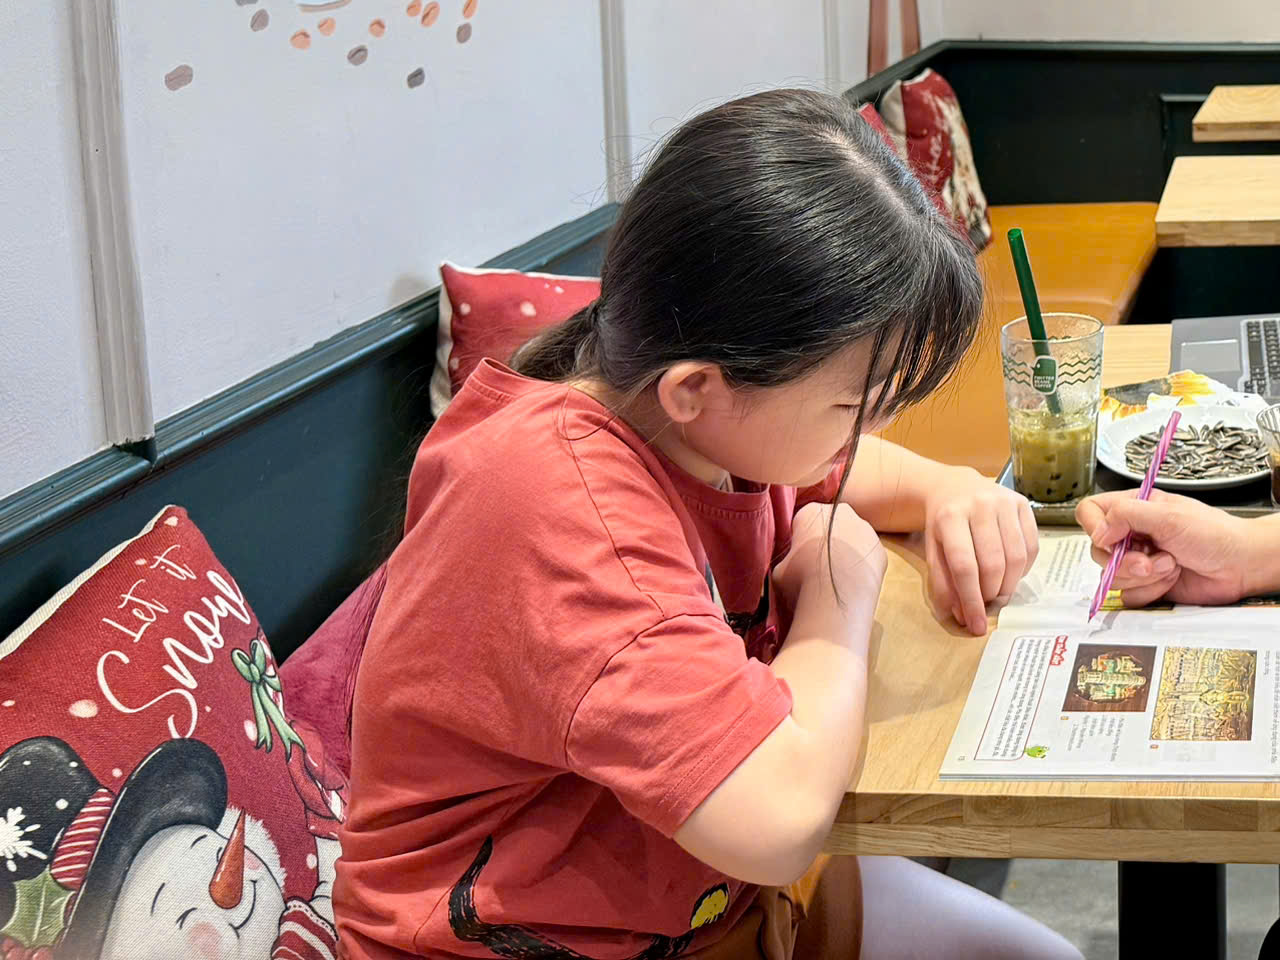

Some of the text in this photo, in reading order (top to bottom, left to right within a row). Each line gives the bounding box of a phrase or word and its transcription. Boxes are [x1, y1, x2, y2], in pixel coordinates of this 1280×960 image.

[97, 570, 250, 740] Snow
[102, 545, 197, 643] Let it
